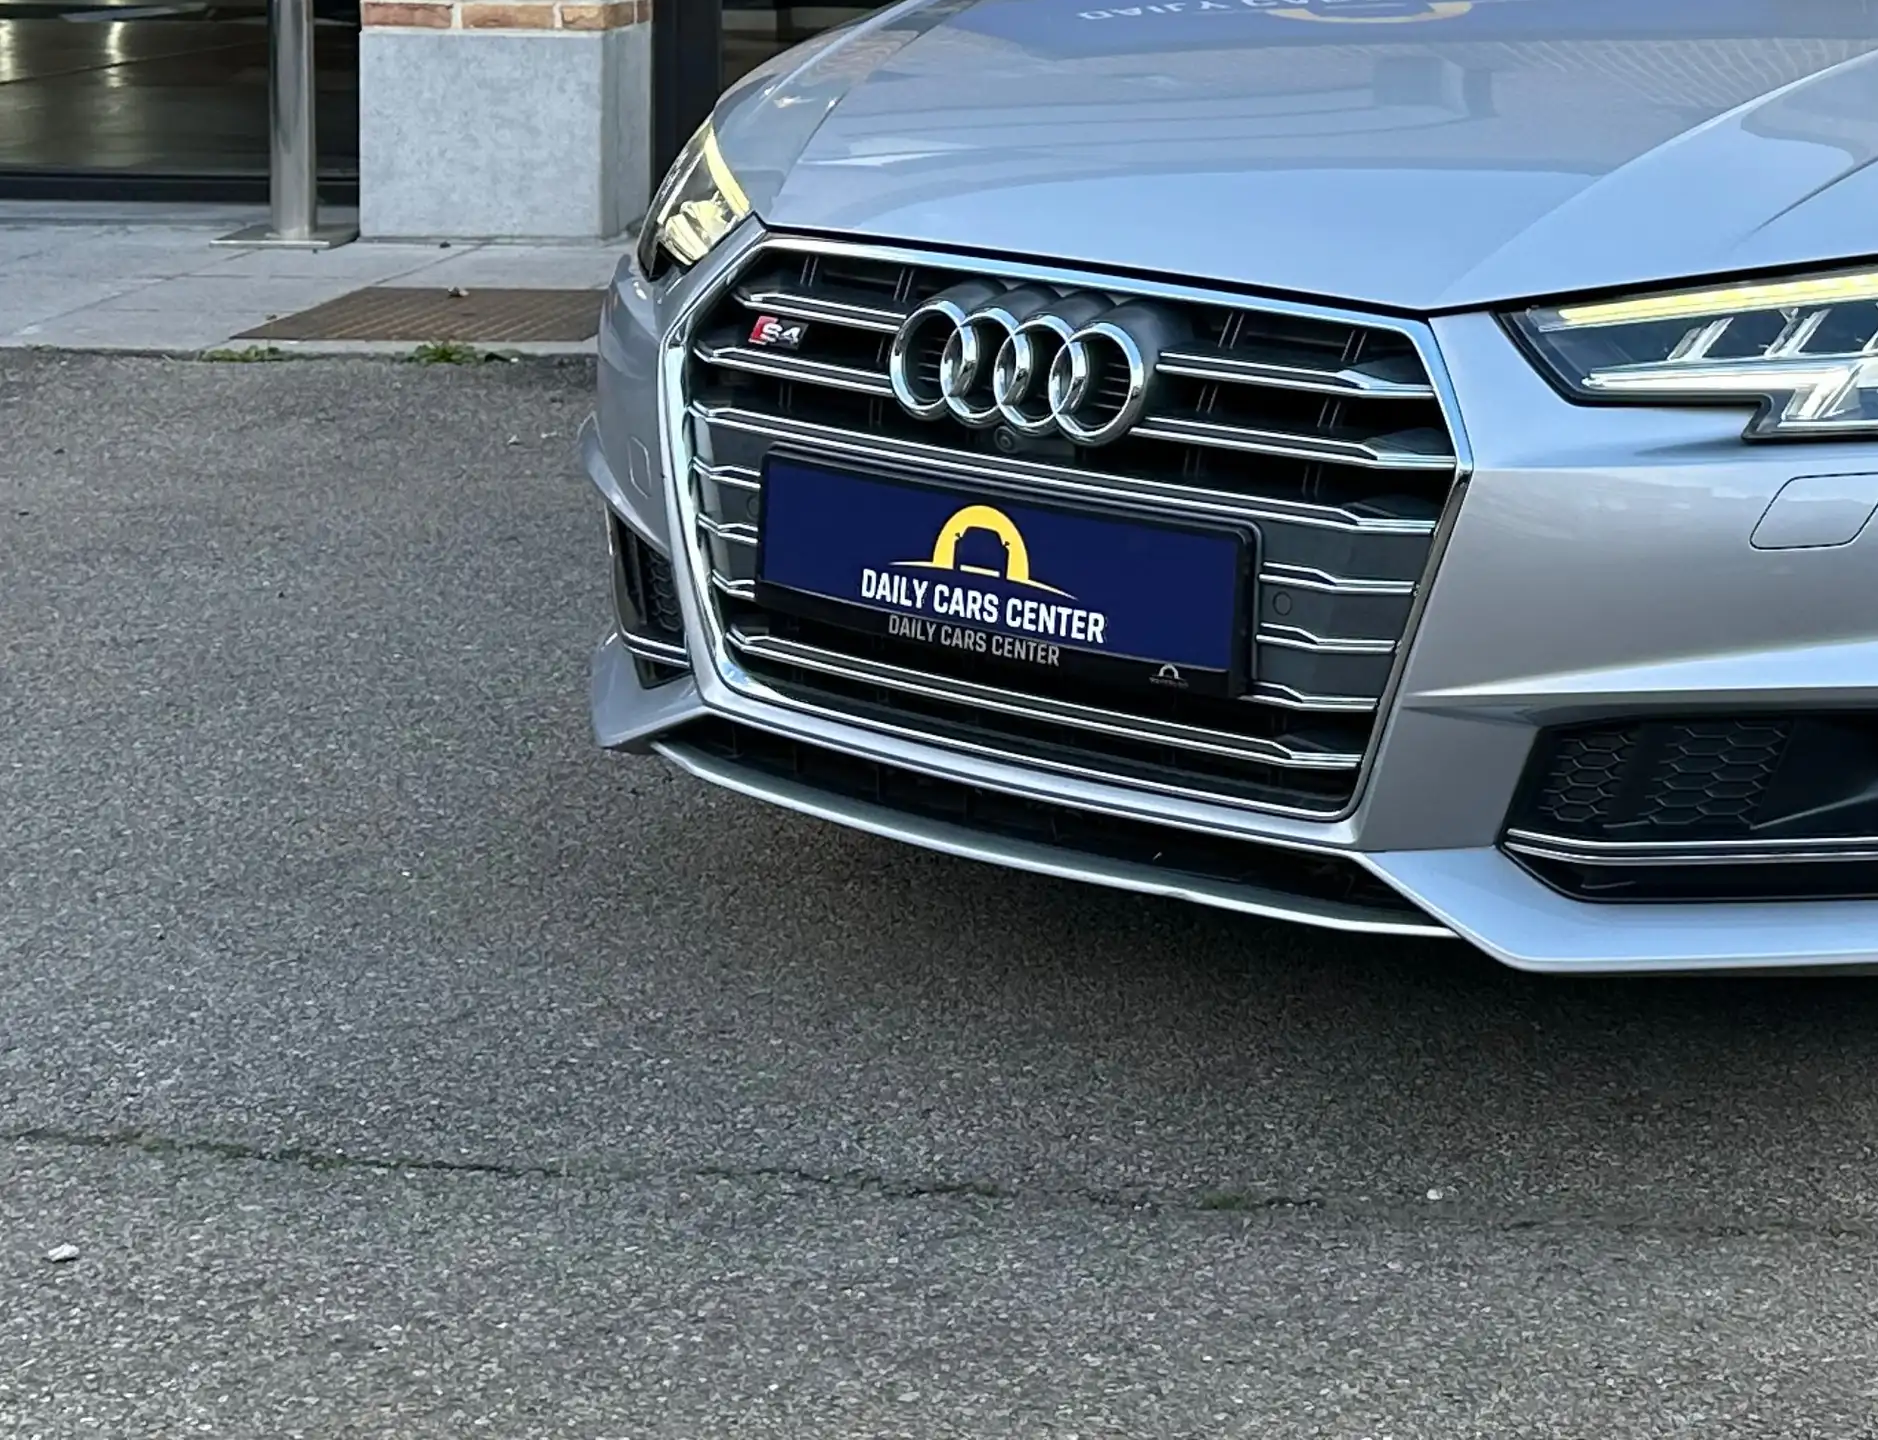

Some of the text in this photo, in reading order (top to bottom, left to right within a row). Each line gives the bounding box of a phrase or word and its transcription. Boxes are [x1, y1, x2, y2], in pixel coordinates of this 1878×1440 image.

[756, 319, 802, 345] S4
[860, 568, 1105, 644] DAILY CARS CENTER
[888, 614, 1060, 667] DAILY CARS CENTER
